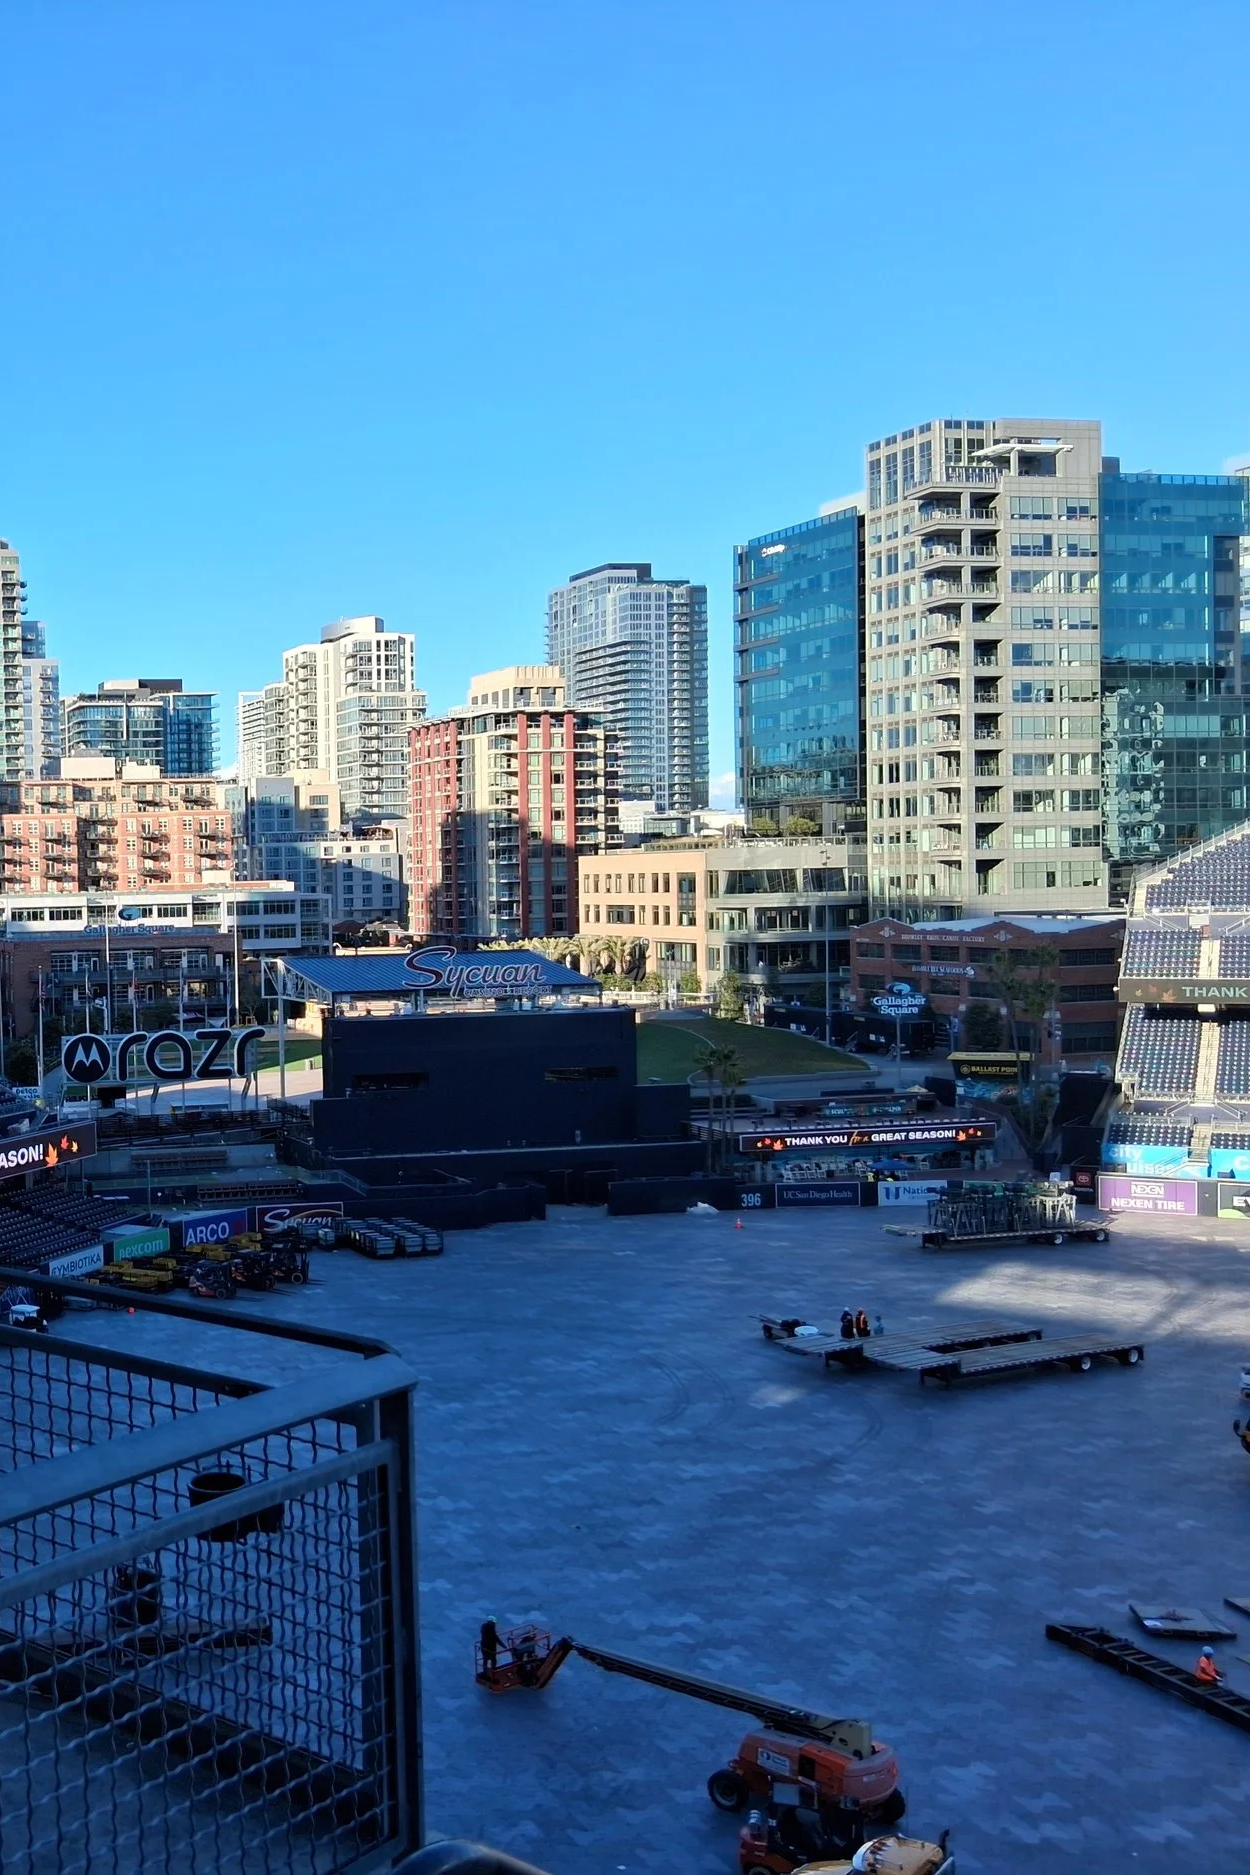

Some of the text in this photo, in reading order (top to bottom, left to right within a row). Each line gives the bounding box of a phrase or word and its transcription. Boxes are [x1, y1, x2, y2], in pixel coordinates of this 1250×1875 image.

[137, 923, 175, 935] Square
[403, 945, 547, 998] Sycuan
[1181, 986, 1248, 998] THANK
[872, 994, 926, 1007] Gallagher
[880, 1005, 918, 1015] Square
[117, 1028, 265, 1081] razr
[785, 1136, 824, 1146] THANK
[824, 1135, 848, 1144] YOU
[848, 1130, 861, 1146] for
[871, 1132, 907, 1142] GREAT
[908, 1129, 956, 1140] SEASON!
[1110, 1145, 1142, 1161] city
[741, 1193, 762, 1207] 396
[783, 1189, 853, 1199] UC San Diego Health
[1111, 1198, 1185, 1211] NEXEN TIRE
[186, 1221, 230, 1247] ARCO
